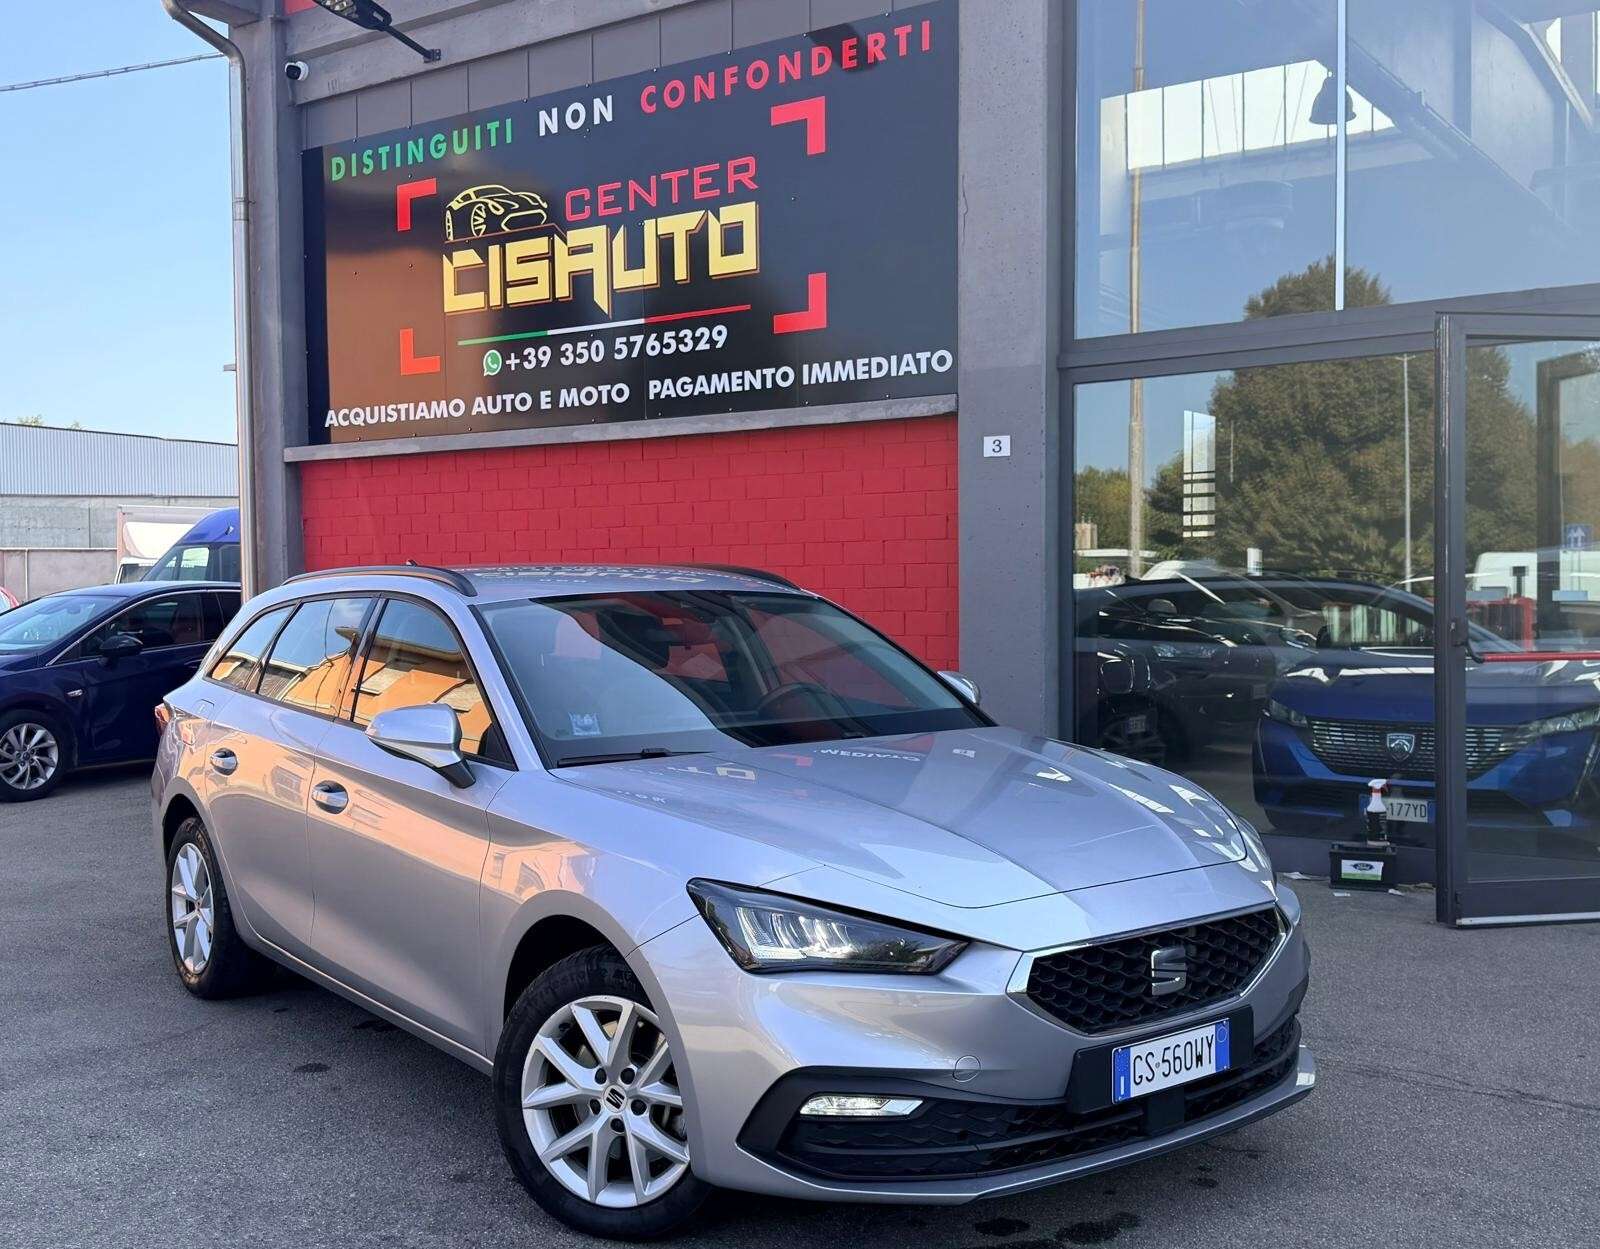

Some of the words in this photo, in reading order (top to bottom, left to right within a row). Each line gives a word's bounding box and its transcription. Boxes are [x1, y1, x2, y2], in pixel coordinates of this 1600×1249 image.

[331, 118, 513, 182] DISTINGUITI
[538, 95, 613, 136] NON
[640, 20, 931, 115] CONFONDERTI
[565, 156, 759, 222] CENTER
[443, 201, 760, 319] CISAUTO
[505, 346, 551, 370] +39
[560, 340, 605, 365] 350
[614, 325, 728, 361] 5765329
[325, 398, 466, 428] ACQUISTIAMO
[472, 391, 532, 416] AUTO
[541, 390, 552, 409] E
[559, 382, 630, 407] MOTO
[648, 365, 795, 401] PAGAMENTO
[802, 349, 953, 385] IMMEDIATO
[992, 439, 1002, 453] 3
